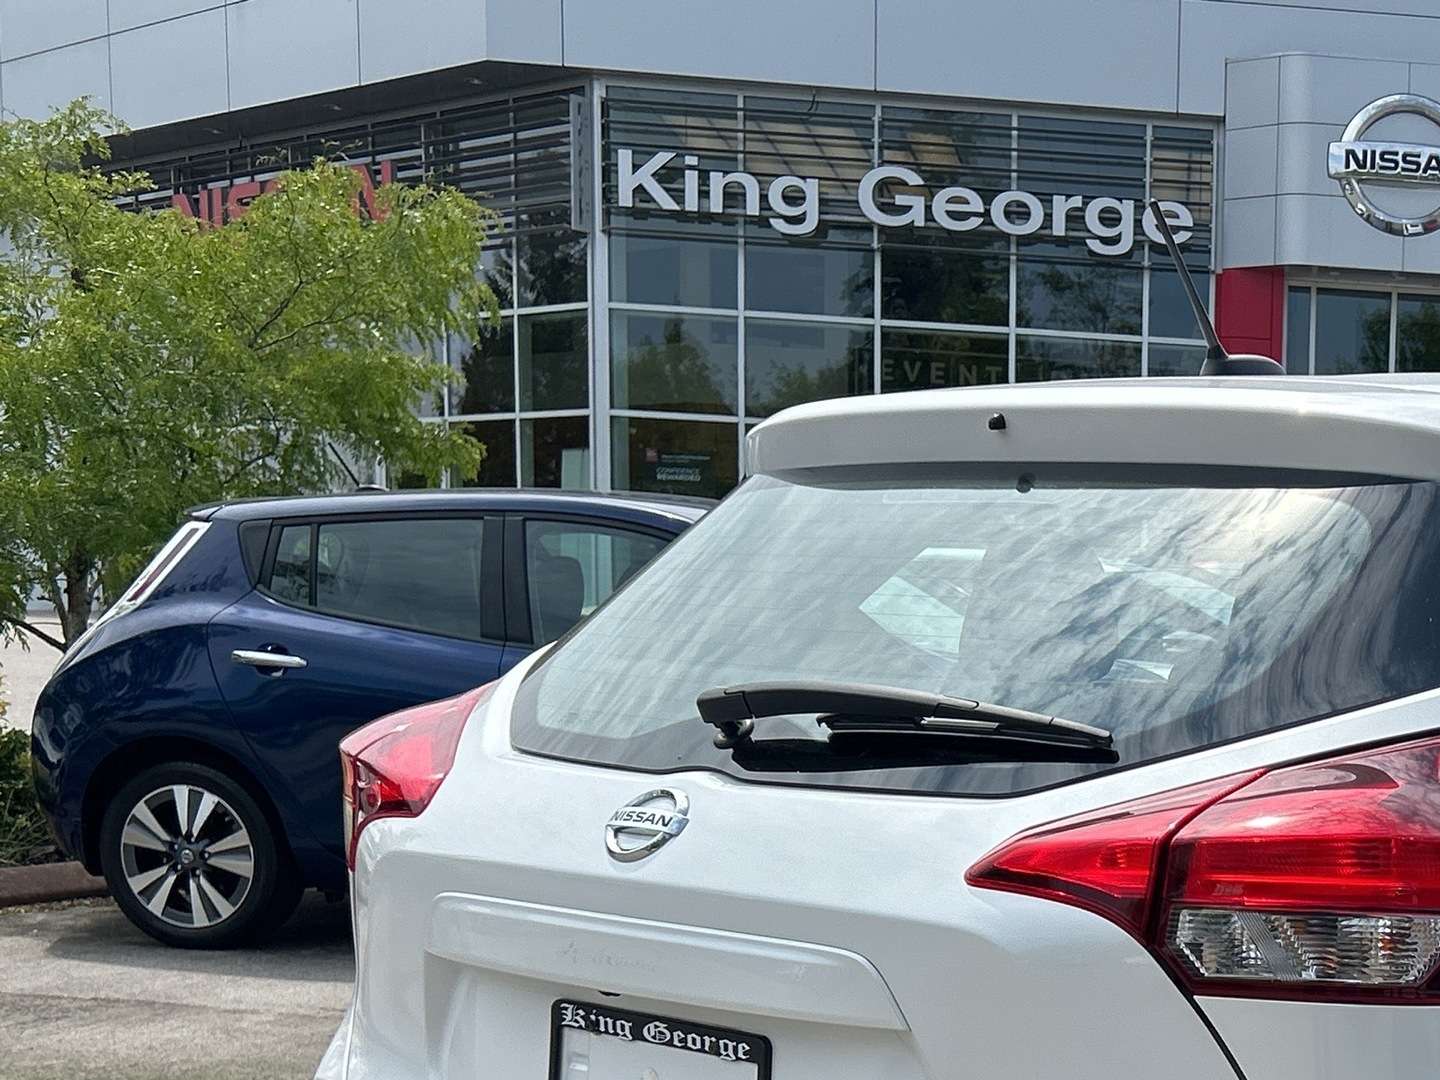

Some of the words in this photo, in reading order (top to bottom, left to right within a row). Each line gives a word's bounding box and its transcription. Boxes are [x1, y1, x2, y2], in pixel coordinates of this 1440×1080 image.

[170, 160, 393, 232] NISN
[617, 148, 820, 236] King
[857, 165, 1195, 257] George
[881, 358, 1003, 385] EVENT
[609, 810, 674, 828] NISSAN
[642, 1021, 751, 1061] George
